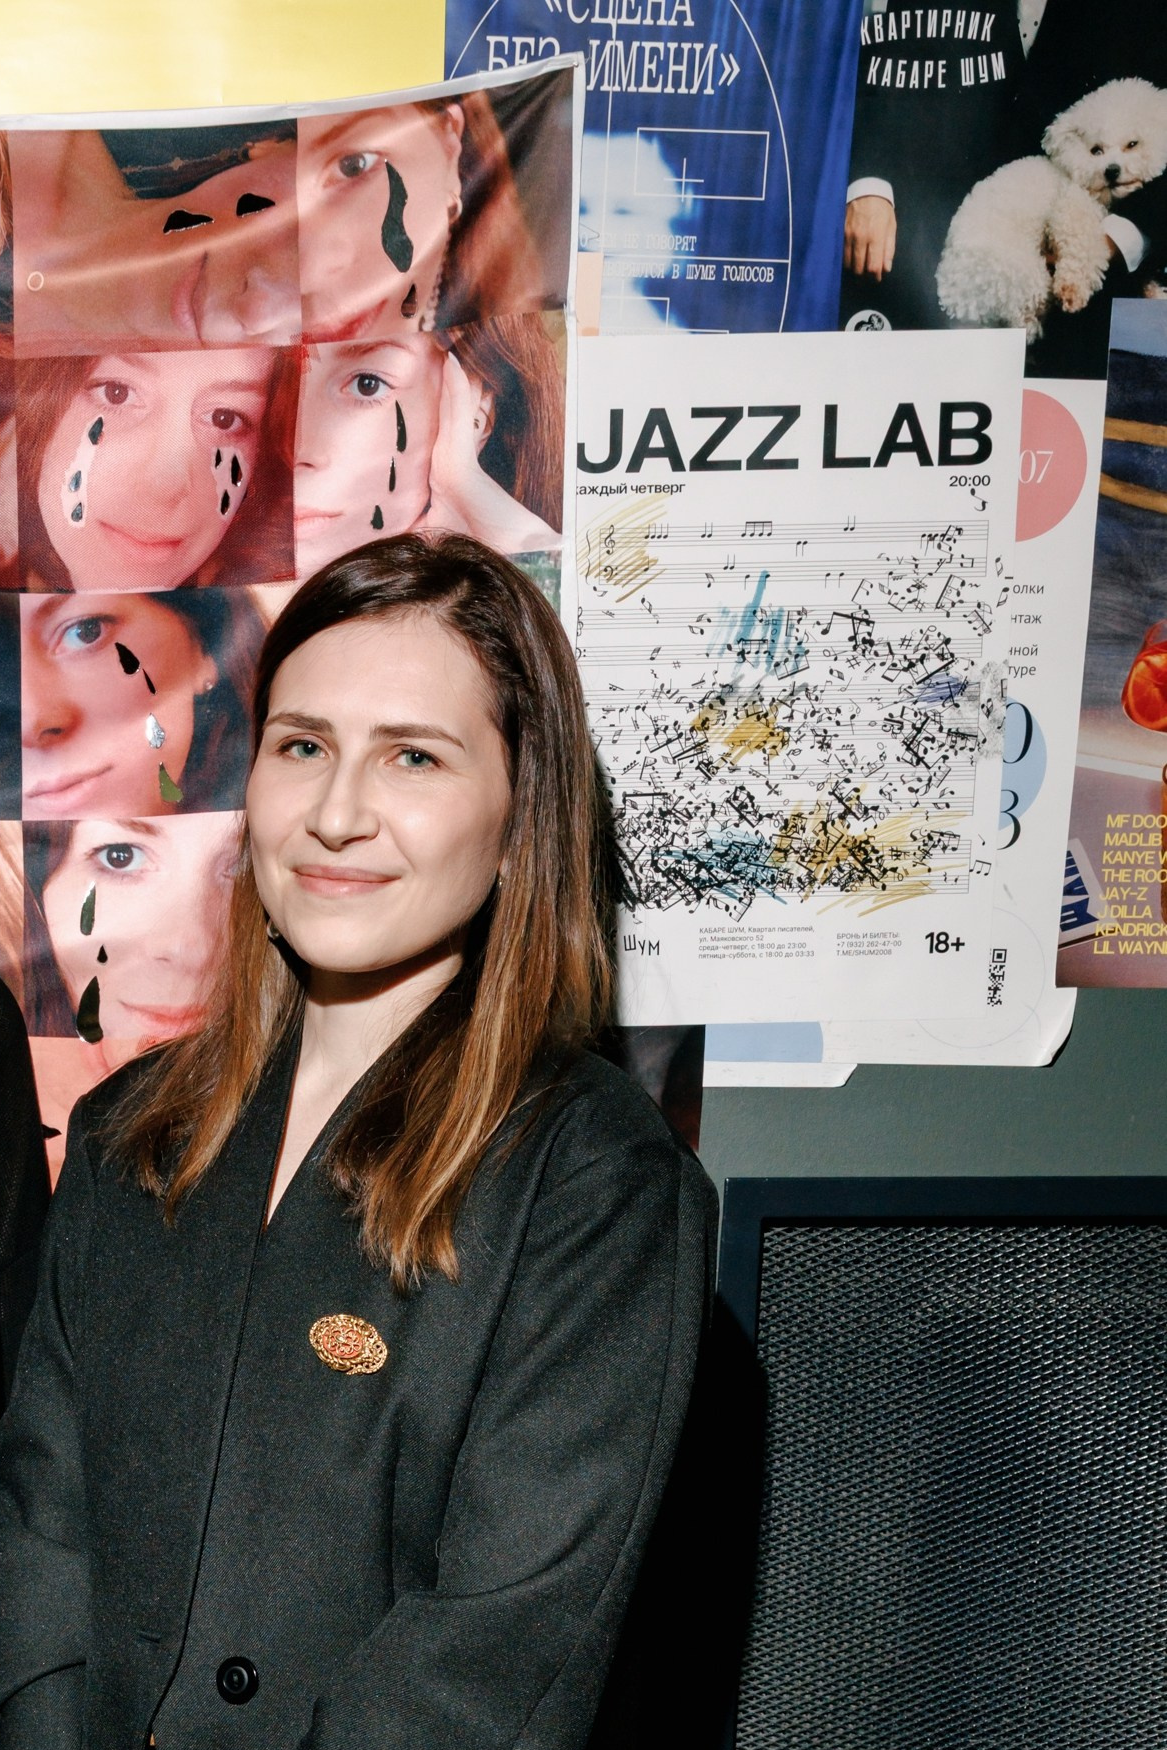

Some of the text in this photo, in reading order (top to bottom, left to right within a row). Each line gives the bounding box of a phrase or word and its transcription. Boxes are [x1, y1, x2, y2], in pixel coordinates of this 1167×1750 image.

[860, 9, 995, 46] КВАРТИРНИК
[586, 39, 740, 95] ИМЕНИ»
[867, 51, 1006, 89] КАБАРЕ ШУМ
[672, 264, 775, 283] В ШУМЕ ГОЛОСОВ
[577, 402, 993, 473] JAZZ LAB
[949, 475, 991, 487] 20:00
[631, 484, 685, 495] четверг
[1106, 814, 1130, 828] MF
[1104, 832, 1163, 847] MADLIB
[1102, 851, 1155, 865] KANYE
[1101, 868, 1132, 883] THE
[1099, 887, 1148, 901] JAY-Z
[1110, 905, 1153, 919] DILLA
[777, 925, 815, 933] писателей,
[1095, 922, 1167, 937] KENDRICK
[624, 934, 660, 956] ШУМ
[847, 940, 865, 949] (932)
[866, 940, 902, 948] 262-47-00
[925, 931, 965, 954] 18+
[1093, 941, 1114, 955] LIL
